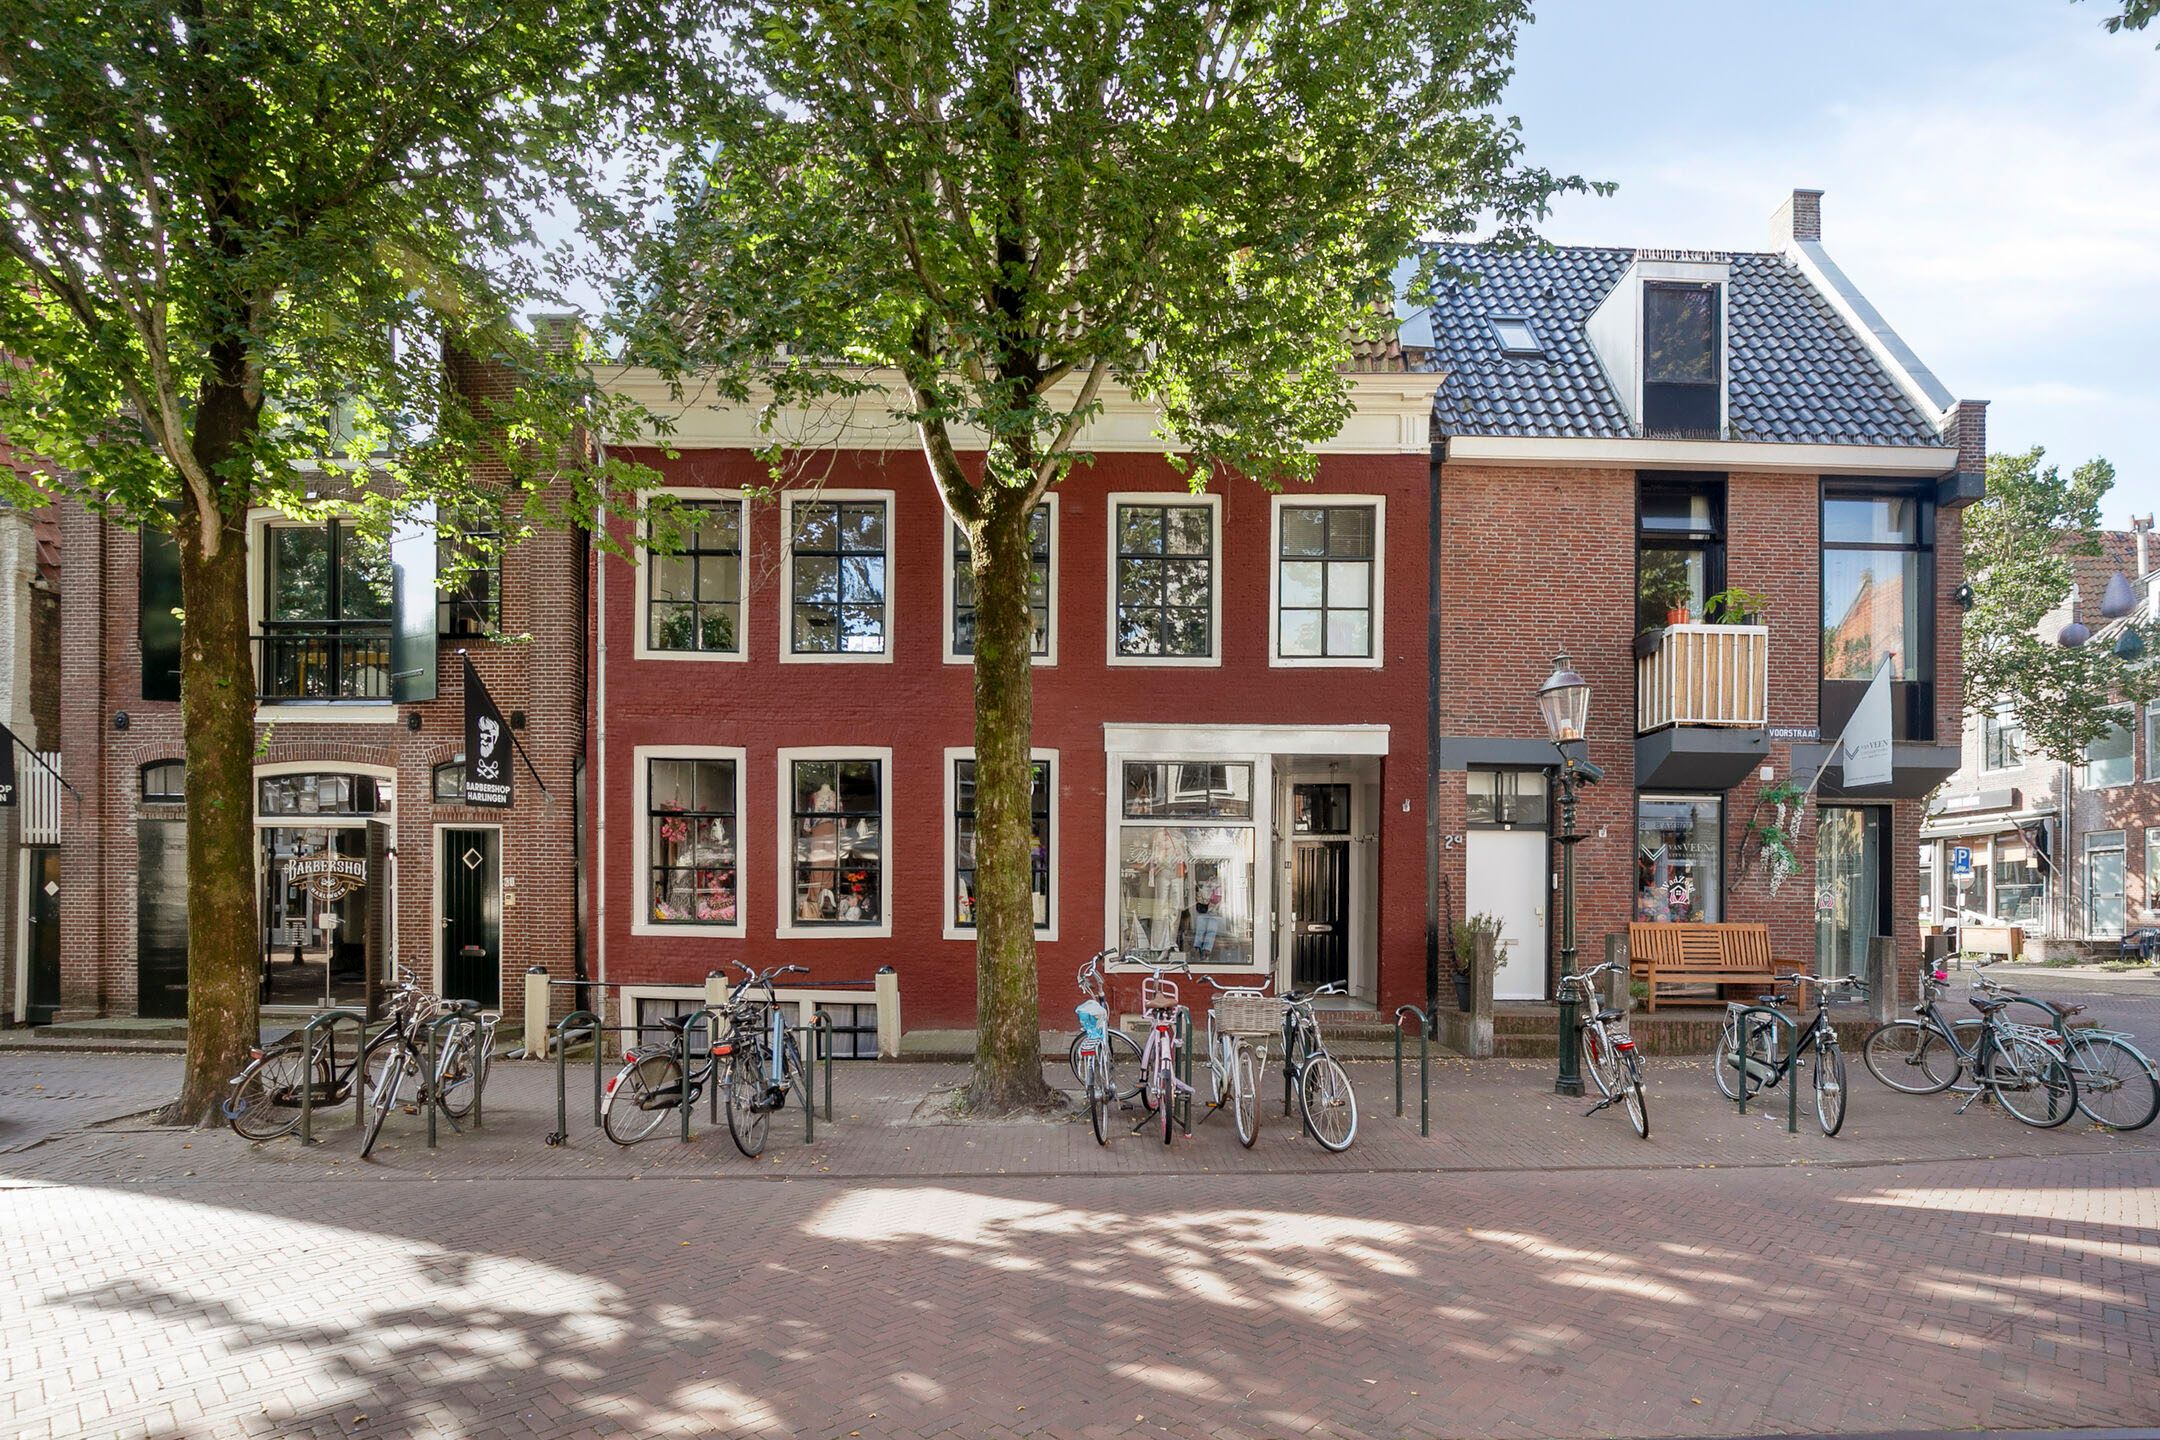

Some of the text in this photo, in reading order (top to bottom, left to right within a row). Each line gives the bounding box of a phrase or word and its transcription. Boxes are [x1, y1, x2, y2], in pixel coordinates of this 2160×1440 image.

[1768, 729, 1817, 738] VOORSTRAAT
[466, 781, 511, 794] BARBERSHOP
[467, 791, 507, 803] HARLINGEN
[1682, 843, 1712, 852] VEEN
[1958, 850, 1968, 864] P
